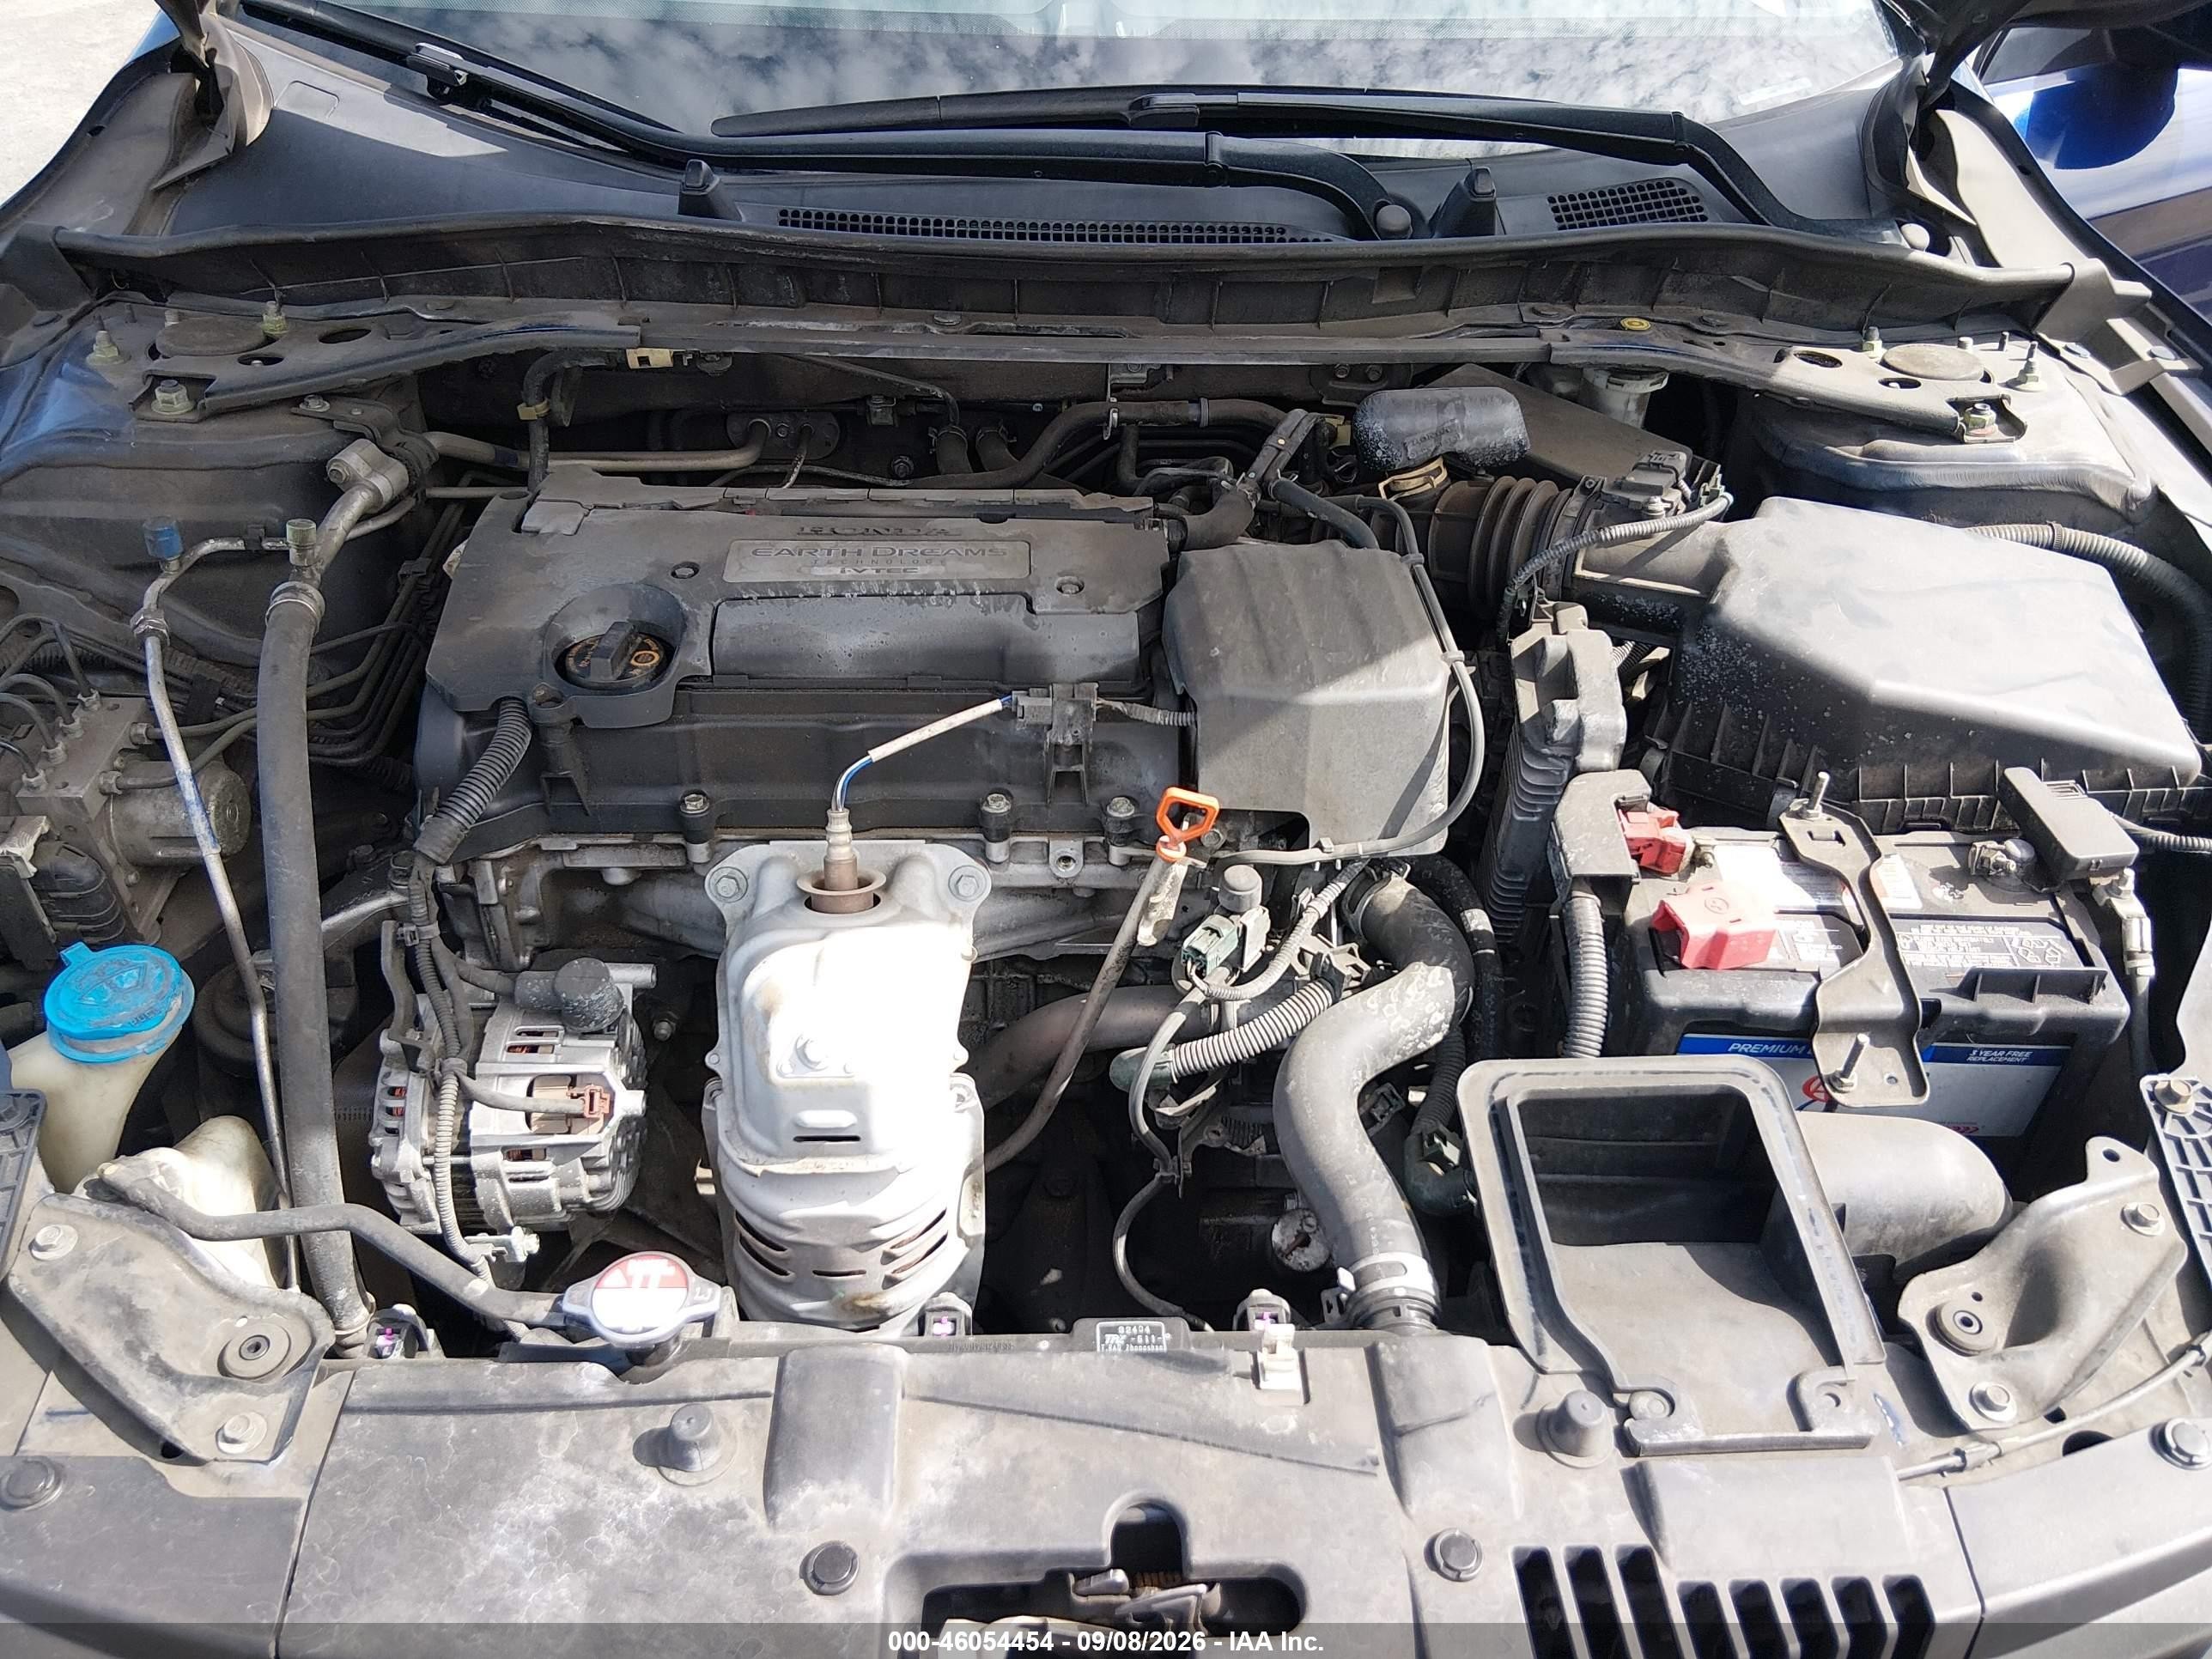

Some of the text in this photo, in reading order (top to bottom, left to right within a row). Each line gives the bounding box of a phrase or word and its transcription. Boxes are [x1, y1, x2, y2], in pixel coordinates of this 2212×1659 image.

[751, 546, 1008, 557] EARTH DREAMS
[1728, 1042, 1806, 1054] PREMIUM
